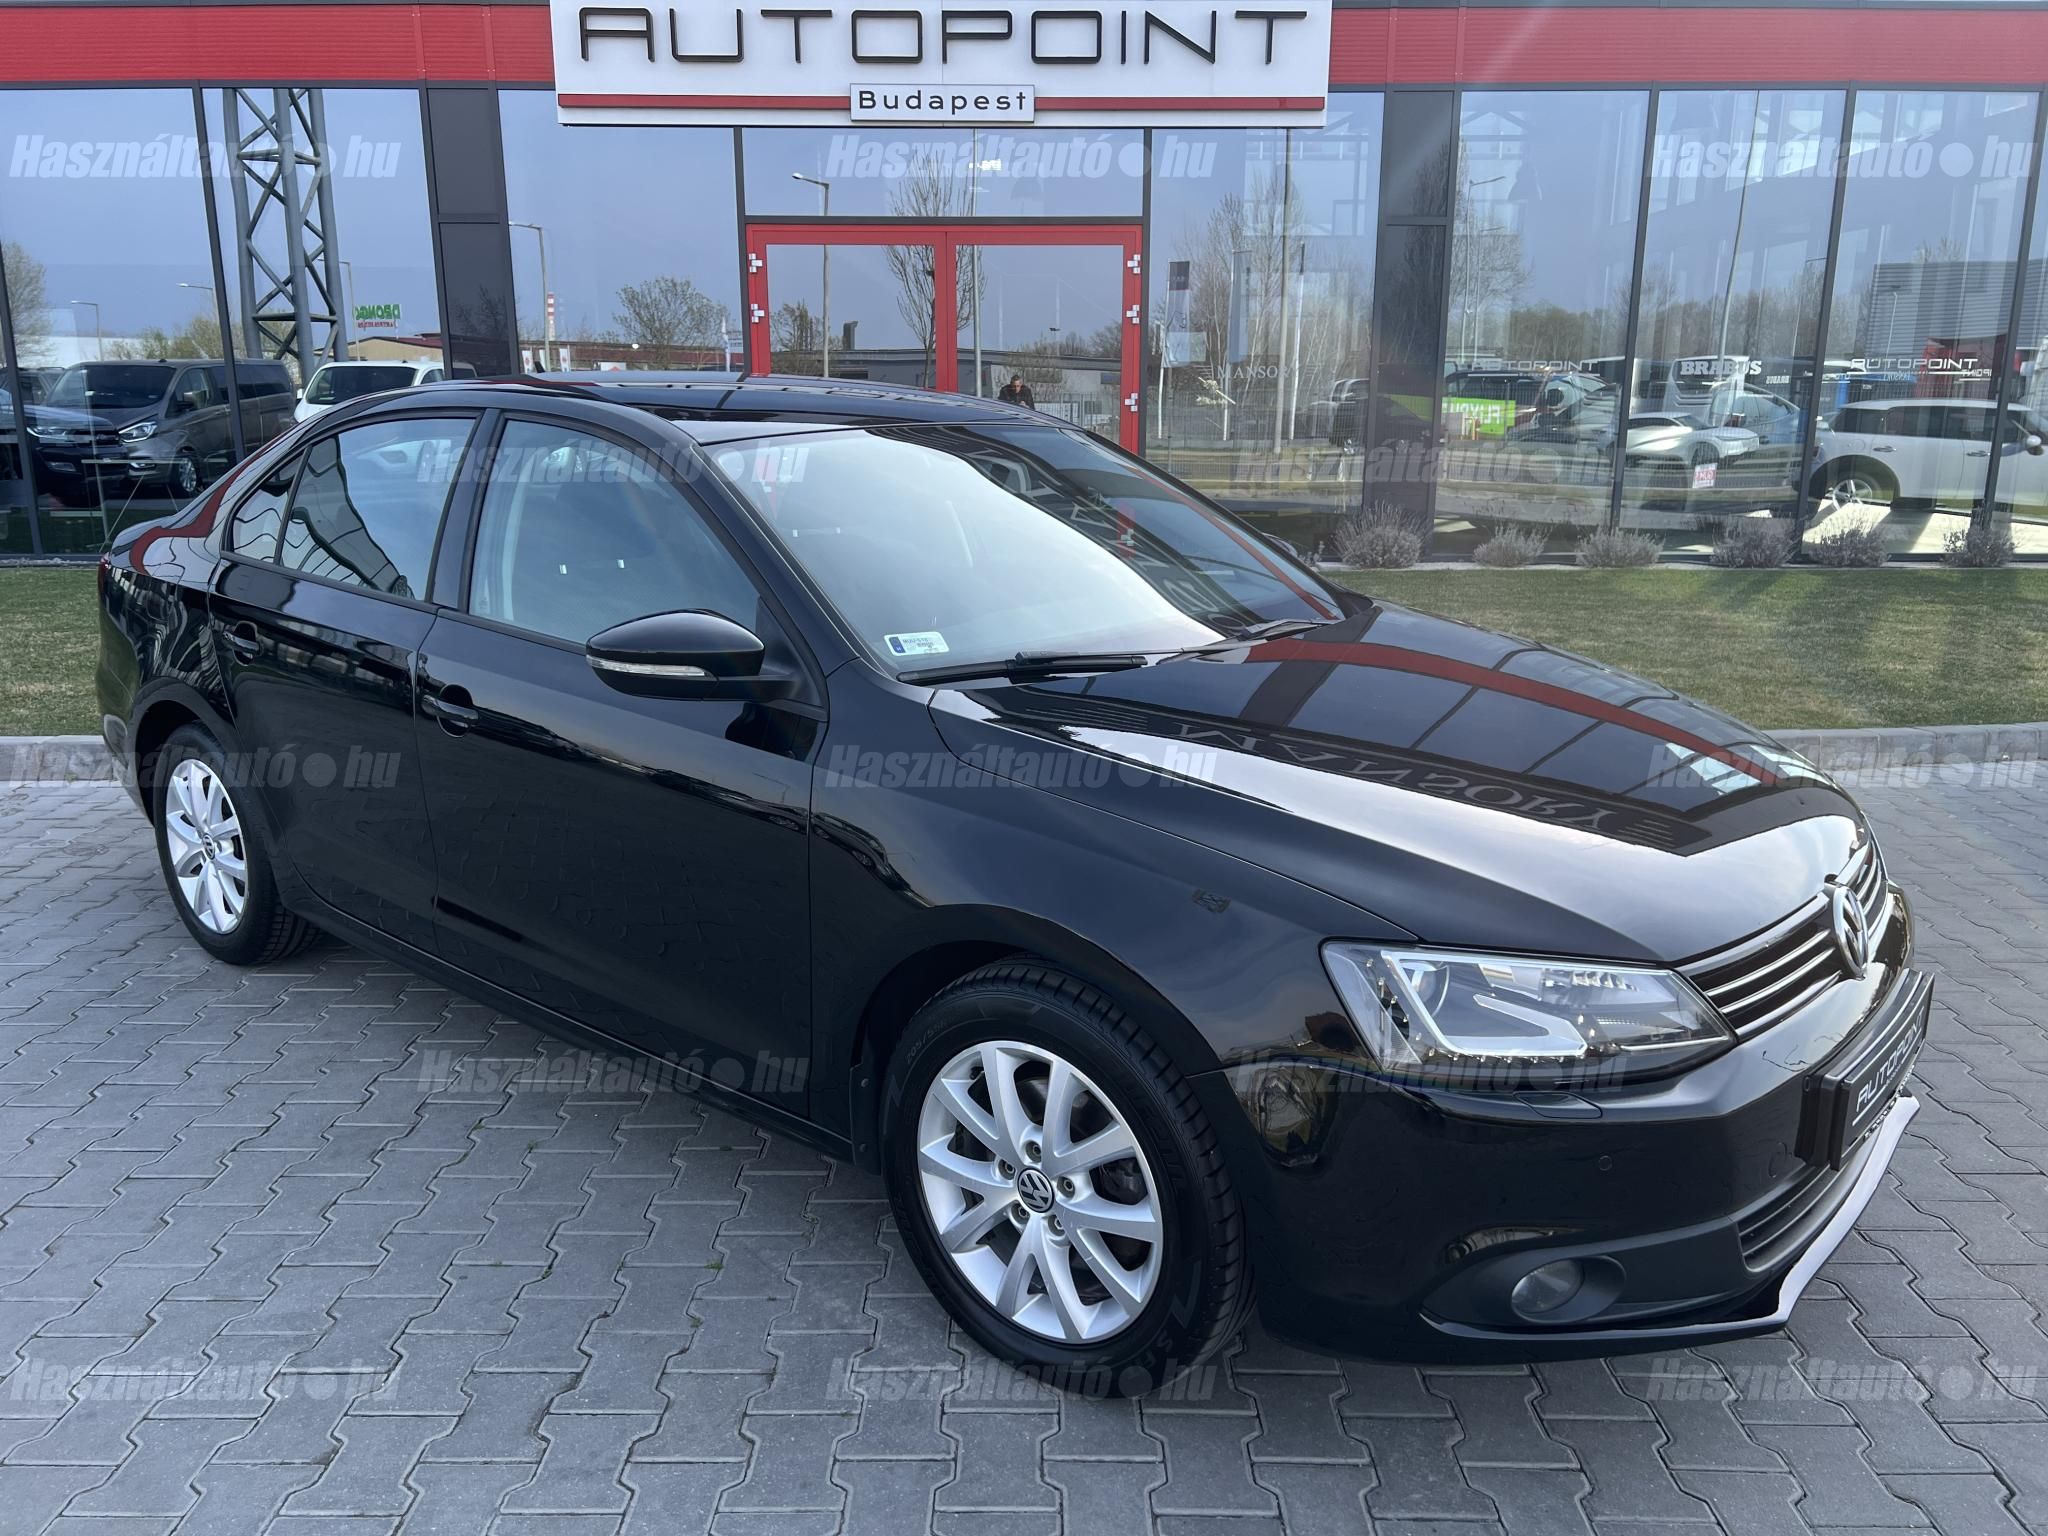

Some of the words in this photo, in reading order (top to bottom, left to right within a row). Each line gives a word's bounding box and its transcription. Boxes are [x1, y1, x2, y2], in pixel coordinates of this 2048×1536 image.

[579, 7, 1307, 64] AUTOPOINT
[859, 90, 1026, 115] Budapest
[1217, 365, 1297, 379] MANSOR
[1680, 360, 1762, 375] BRABUS
